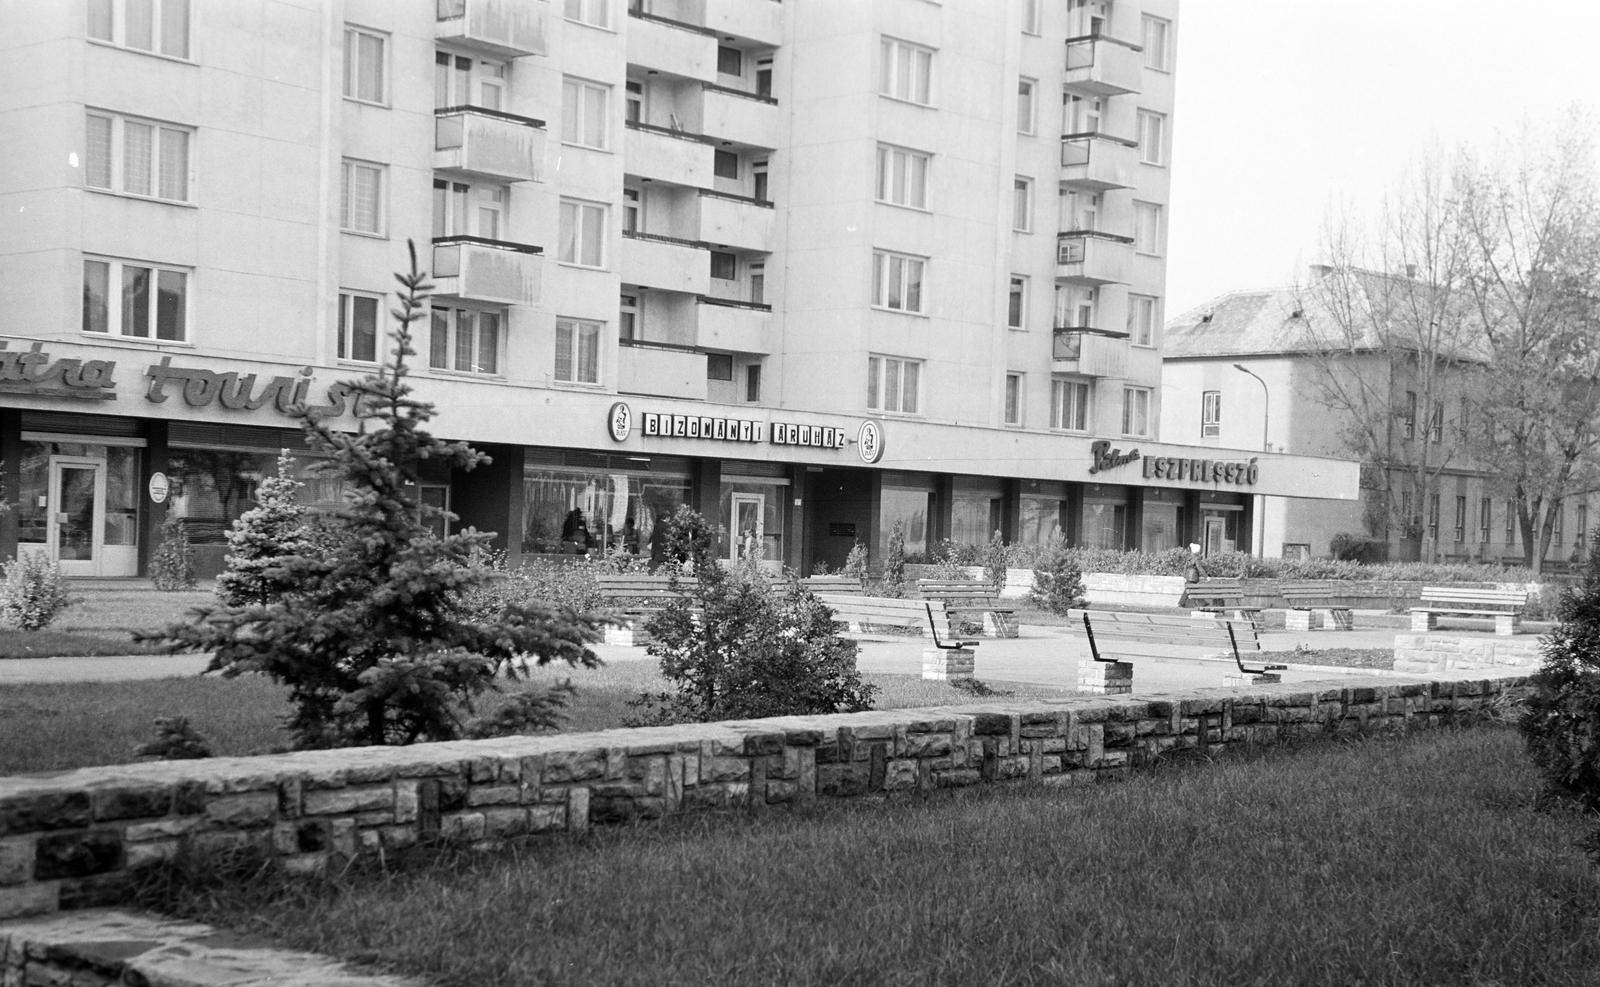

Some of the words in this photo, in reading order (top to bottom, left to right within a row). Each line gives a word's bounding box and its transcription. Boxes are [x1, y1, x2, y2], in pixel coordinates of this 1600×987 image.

[649, 417, 763, 442] BIZOMÁNYI
[777, 423, 846, 447] ÁRUHÁZ
[1142, 455, 1259, 486] ESZPRESSZÓ
